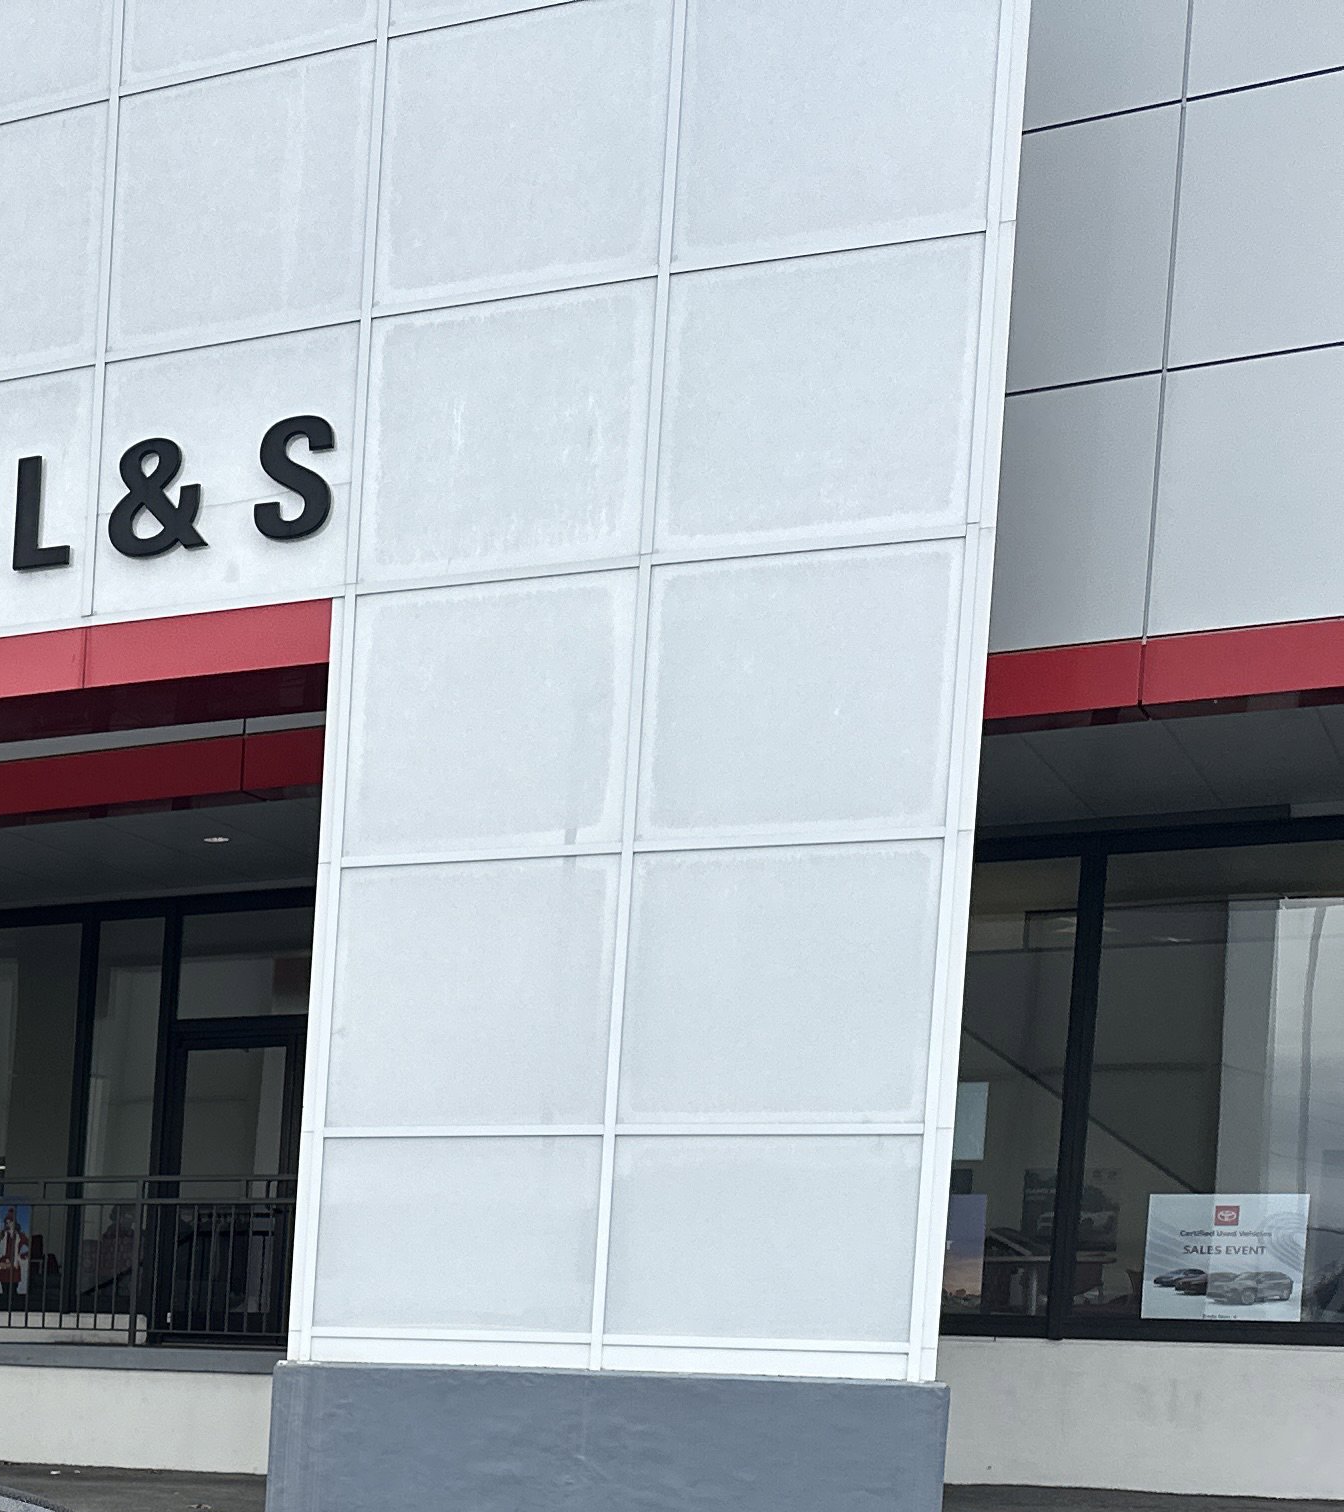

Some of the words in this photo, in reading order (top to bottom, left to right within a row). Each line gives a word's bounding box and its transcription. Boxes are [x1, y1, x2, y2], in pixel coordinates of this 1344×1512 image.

[13, 455, 70, 570] L
[108, 437, 208, 558] &
[254, 415, 335, 541] S
[1183, 1245, 1222, 1255] SALES
[1225, 1245, 1266, 1255] EVENT
